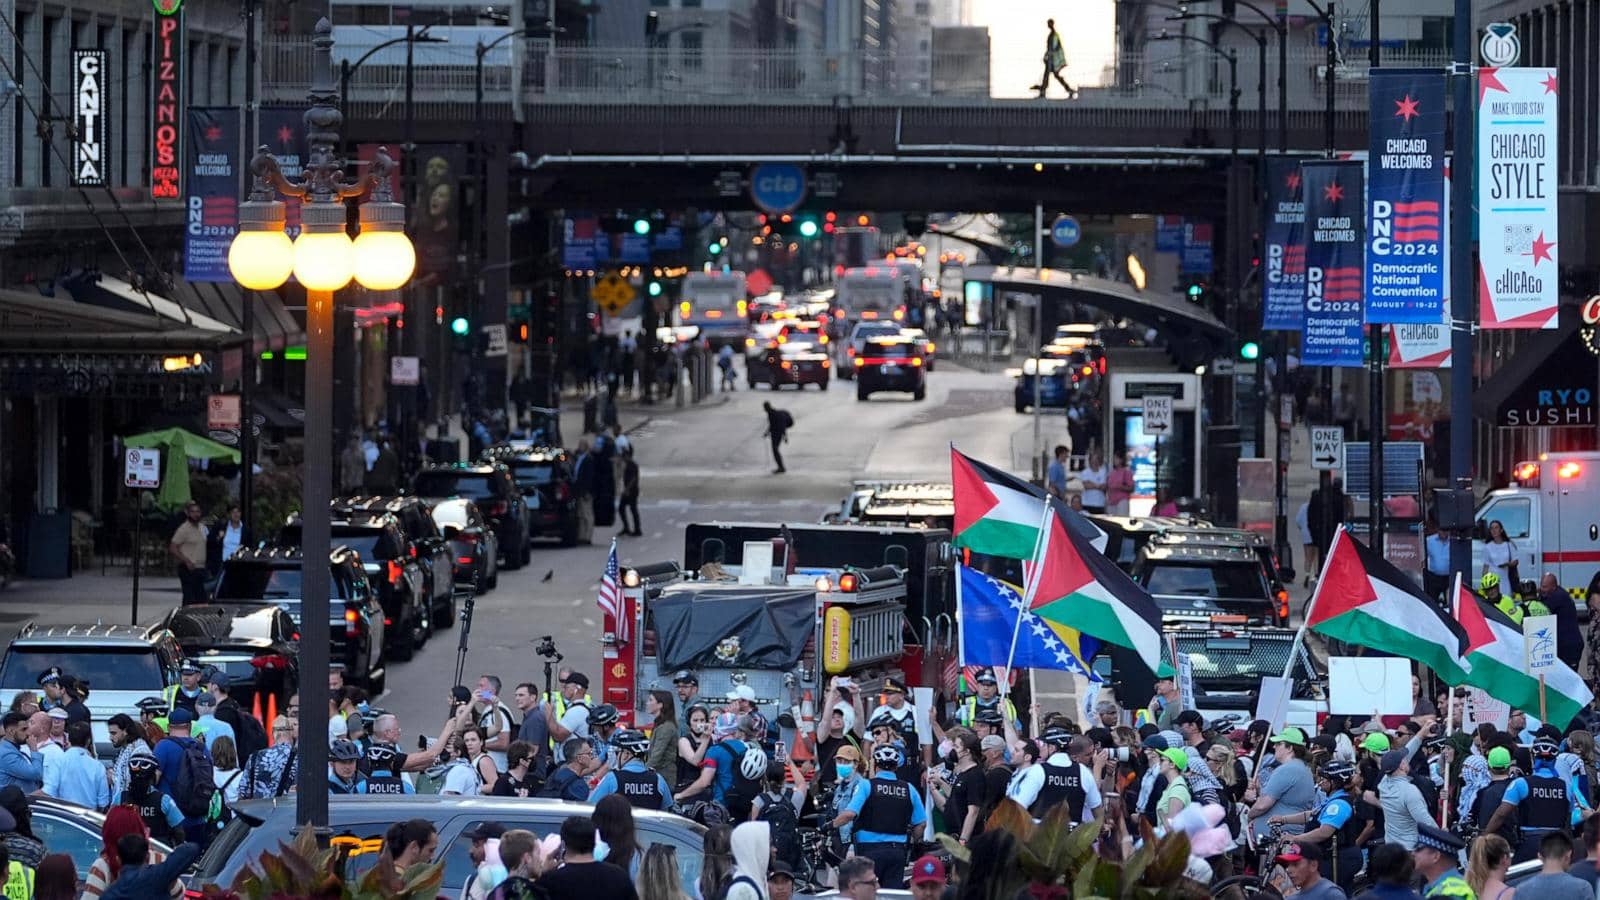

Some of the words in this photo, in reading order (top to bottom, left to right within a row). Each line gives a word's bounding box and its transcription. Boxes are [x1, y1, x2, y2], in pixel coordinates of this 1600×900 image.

[1491, 102, 1510, 114] MAKE
[1511, 102, 1529, 114] YOUR
[1529, 102, 1545, 114] STAY
[80, 56, 100, 179] CANTINA
[1386, 139, 1427, 153] CHICAGO
[1491, 133, 1545, 159] CHICAGO
[199, 154, 228, 165] CHICAGO
[1381, 154, 1432, 169] WELCOMES
[195, 165, 231, 177] WELCOMES
[760, 173, 798, 193] cta
[1491, 163, 1546, 199] STYLE
[188, 196, 203, 236] DNC
[1317, 217, 1351, 229] CHICAGO
[1371, 200, 1393, 256] DNC
[203, 226, 235, 236] 2024
[1313, 230, 1355, 242] WELCOMES
[1393, 243, 1438, 256] 2024
[1268, 244, 1283, 283] DNC
[1372, 263, 1438, 274] Democratic
[1282, 274, 1305, 283] 202
[1372, 275, 1421, 285] National
[1307, 266, 1323, 312] DNC
[1372, 286, 1438, 297] Convention
[1323, 302, 1360, 312] 2024
[1307, 317, 1360, 327] Democratic
[1306, 326, 1346, 336] National
[1306, 335, 1360, 345] Convention
[1539, 388, 1591, 406] RYO
[1146, 400, 1169, 409] ONE
[1147, 410, 1169, 419] WAY
[1507, 406, 1591, 426] SUSHI
[1314, 430, 1339, 441] ONE
[1314, 442, 1339, 452] WAY
[1048, 775, 1079, 787] POLICE
[369, 783, 401, 794] POLICE
[624, 783, 654, 795] POLICE
[877, 784, 907, 797] POLICE
[1532, 787, 1564, 799] POLICE
